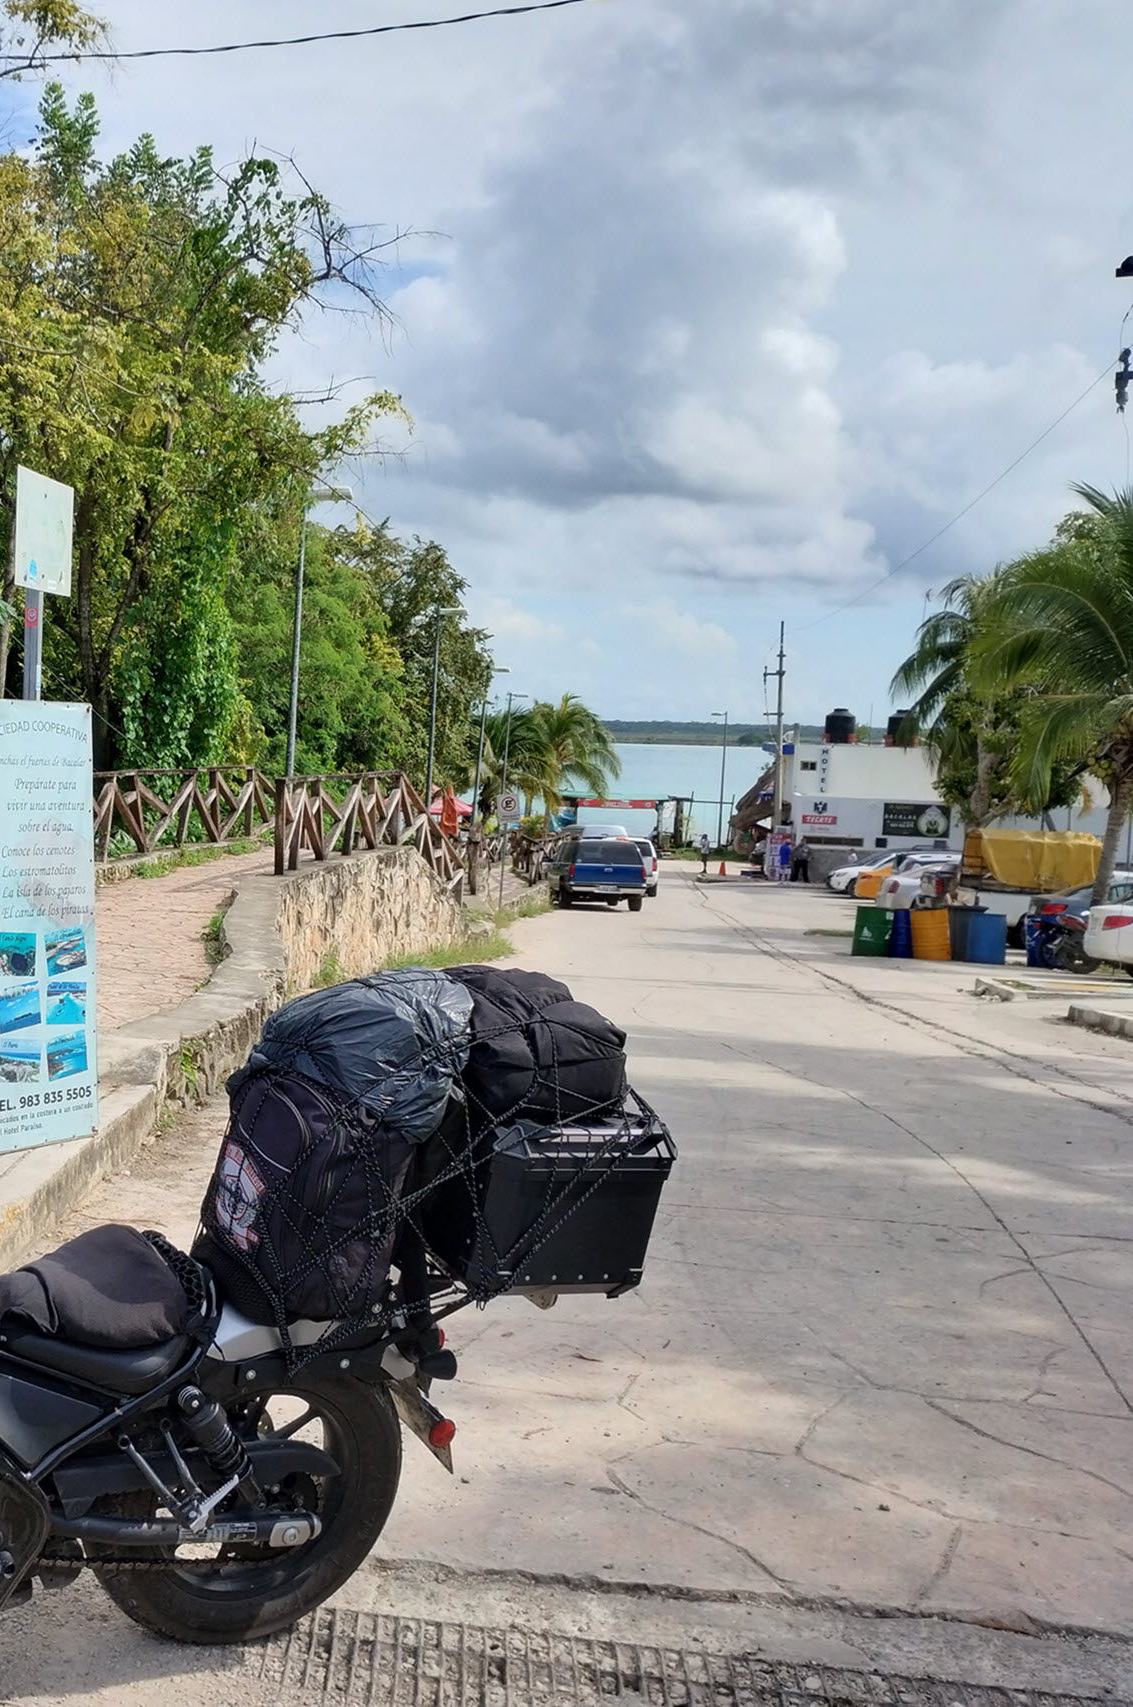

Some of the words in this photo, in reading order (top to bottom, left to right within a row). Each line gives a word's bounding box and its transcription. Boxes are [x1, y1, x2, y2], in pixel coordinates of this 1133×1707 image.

[32, 721, 87, 744] COOPERATIVA
[820, 749, 829, 793] HOTEL
[14, 777, 56, 793] Prepárate
[58, 780, 76, 793] para
[7, 799, 28, 811] vivir
[30, 802, 45, 811] una
[47, 801, 84, 811] aventura
[18, 819, 40, 832] sobre
[42, 819, 51, 832] el
[1, 845, 30, 858] Conoce
[33, 843, 44, 856] los
[46, 846, 75, 856] cenotes
[2, 866, 17, 878] Los
[20, 863, 76, 876] estromatolitos
[2, 887, 13, 898] La
[17, 884, 30, 898] isla
[33, 884, 42, 897] de
[44, 883, 55, 896] los
[2, 905, 15, 919] El
[37, 904, 46, 917] de
[48, 903, 59, 916] los
[19, 1094, 40, 1109] 983
[43, 1090, 63, 1104] 835
[66, 1085, 92, 1101] 5505
[21, 1113, 28, 1121] en
[30, 1111, 35, 1119] la
[3, 1126, 19, 1135] Hotel
